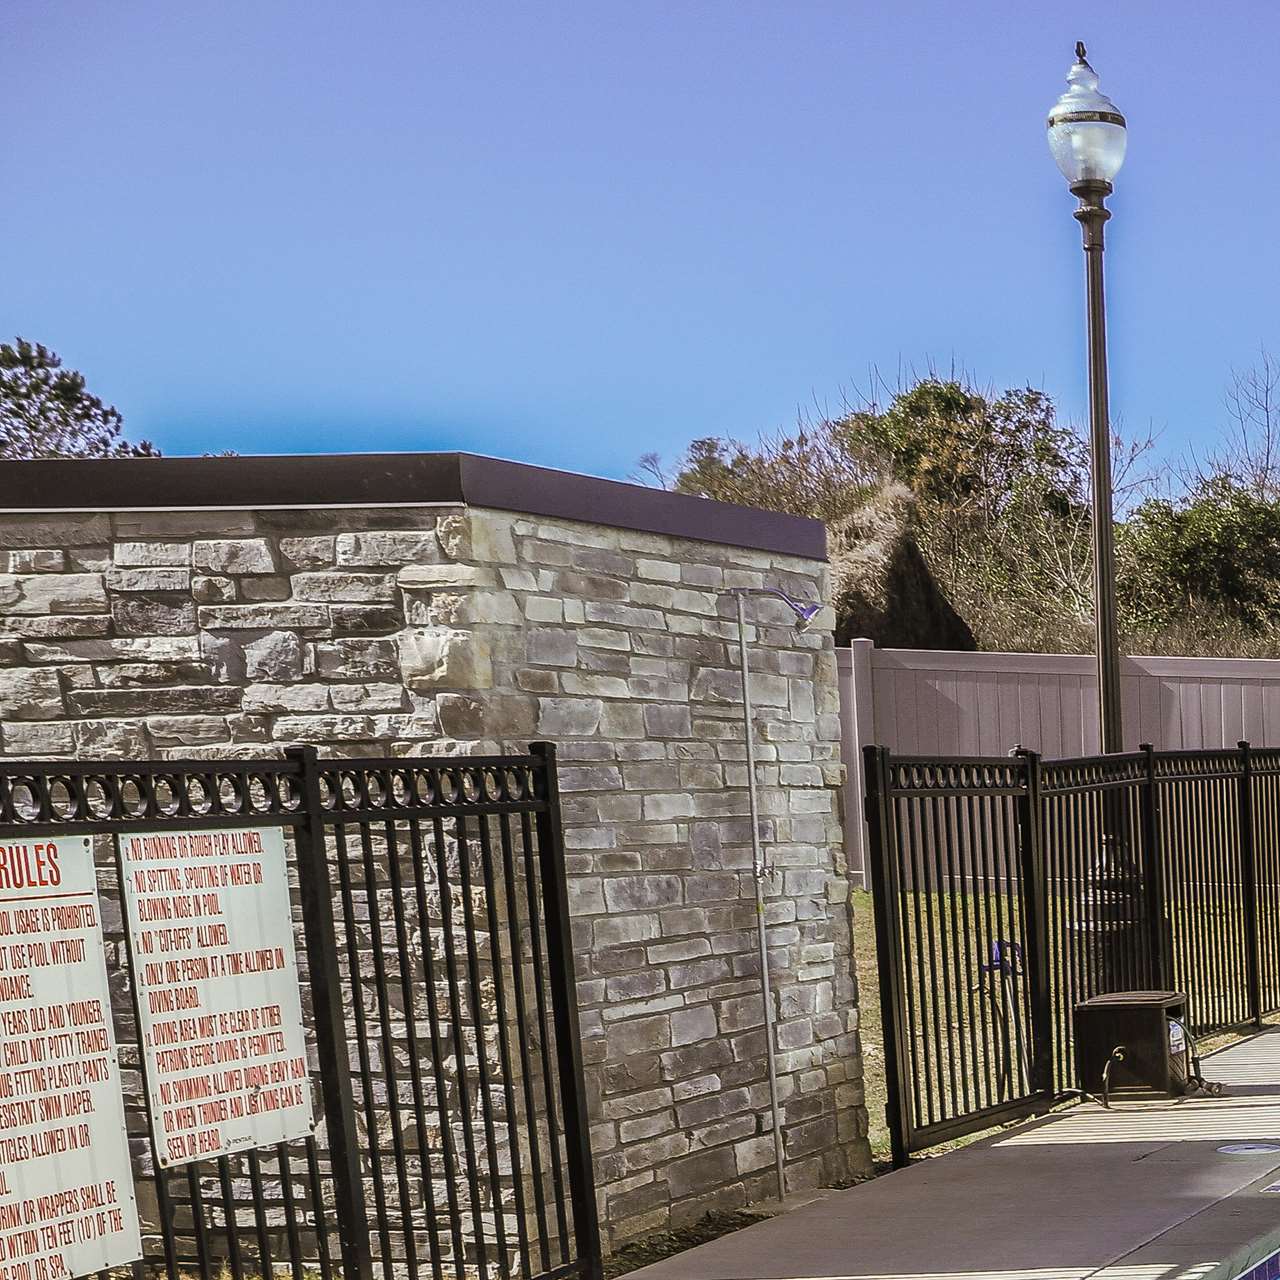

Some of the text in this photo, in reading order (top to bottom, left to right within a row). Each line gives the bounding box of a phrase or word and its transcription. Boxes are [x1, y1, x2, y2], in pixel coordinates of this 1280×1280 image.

[130, 838, 142, 861] NO
[143, 835, 177, 860] RUNNING
[178, 835, 189, 858] OR
[190, 834, 213, 857] ROUGH
[213, 832, 230, 856] PLAY
[231, 832, 264, 854] ALLOWED.
[0, 843, 61, 889] RULES
[134, 870, 146, 893] NO
[184, 865, 219, 890] SPOUTING
[220, 864, 228, 887] OF
[229, 863, 252, 886] WATER
[252, 862, 263, 884] OR
[14, 908, 41, 934] USAGE
[41, 907, 51, 931] IS
[51, 904, 98, 931] PROHIBITED.
[138, 893, 223, 921] BLOWING NOSE IN POOL.
[10, 938, 86, 970] USE POOL WITHOUT
[141, 930, 154, 954] NO
[197, 923, 230, 948] ALLOWED.
[145, 962, 164, 986] ONLY
[165, 960, 180, 983] ONE
[181, 957, 209, 981] PERSON
[210, 956, 218, 977] AT
[226, 953, 244, 975] TIME
[245, 948, 274, 973] ALLOWED
[274, 947, 285, 969] ON
[149, 986, 201, 1014] DIVING BOARD.
[1, 1009, 29, 1036] YEARS
[30, 1007, 46, 1032] OLD
[48, 1004, 66, 1029] AND
[152, 1021, 178, 1046] DIVING
[179, 1018, 198, 1042] AREA
[198, 1014, 218, 1039] MUST
[218, 1012, 229, 1035] BE
[229, 1009, 251, 1034] CLEAR
[251, 1008, 260, 1030] OF
[260, 1005, 282, 1029] OTHER
[3, 1040, 28, 1067] CHILD
[30, 1037, 46, 1063] NOT
[48, 1033, 75, 1060] POTTY
[155, 1047, 189, 1074] PATRONS
[189, 1043, 216, 1069] BEFORE
[215, 1038, 240, 1064] DIVING
[240, 1036, 247, 1059] IS
[15, 1067, 47, 1096] FITTING
[48, 1062, 81, 1090] PLASTIC
[82, 1057, 109, 1083] PANTS
[160, 1056, 306, 1106] NO SWIMMING ALLOWED DURING HEAVY RAIN
[39, 1095, 63, 1122] SWIM
[64, 1089, 95, 1117] DIAPER.
[163, 1083, 304, 1133] OR WHEN THUNDER AND LIGHTNING CAN BE
[31, 1128, 67, 1158] ALLOWED
[68, 1126, 78, 1150] IN
[79, 1123, 91, 1148] OR
[167, 1135, 187, 1160] SEEN
[187, 1133, 197, 1157] OR
[23, 1199, 37, 1224] OR
[37, 1189, 80, 1222] WRAPPERS
[80, 1183, 106, 1210] SHALL
[106, 1180, 117, 1204] BE
[7, 1229, 39, 1260] WITHIN
[40, 1225, 58, 1250] TEN
[58, 1219, 77, 1247] FEET
[97, 1211, 106, 1236] OF
[108, 1207, 124, 1233] THE
